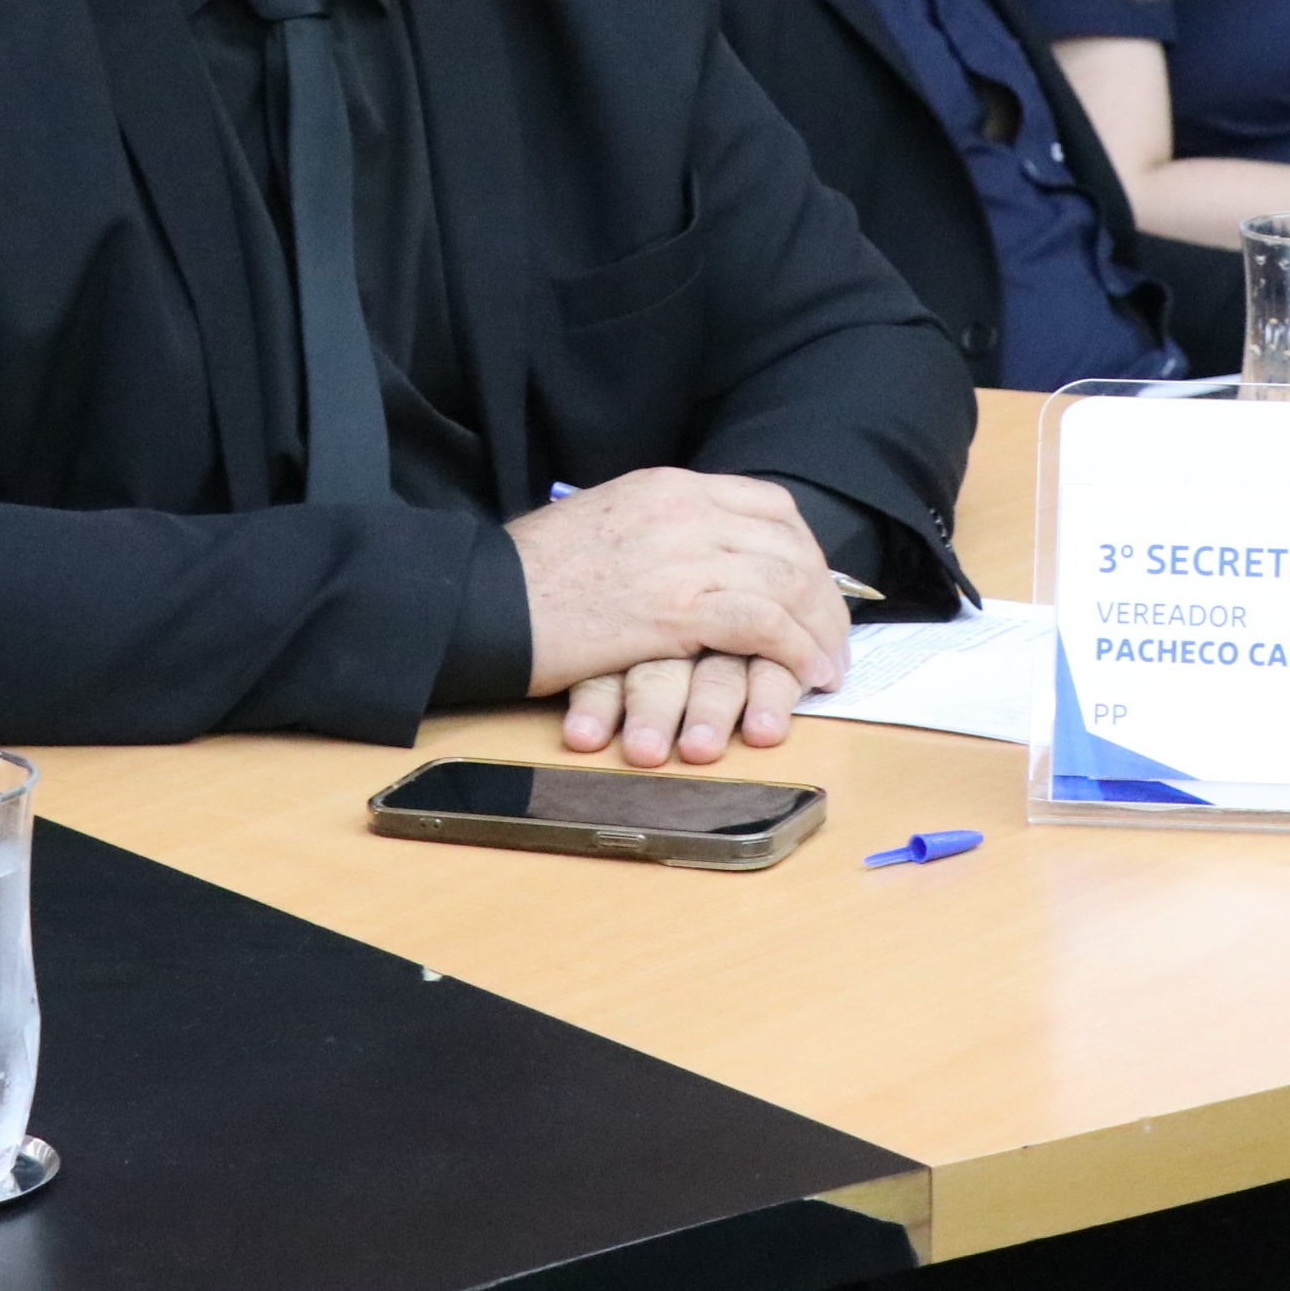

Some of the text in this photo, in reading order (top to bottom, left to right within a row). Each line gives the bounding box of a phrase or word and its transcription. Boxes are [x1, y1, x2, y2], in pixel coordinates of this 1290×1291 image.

[1096, 601, 1248, 628] VEREADOR
[1095, 637, 1239, 665] PACHECO
[1094, 703, 1128, 725] PP
